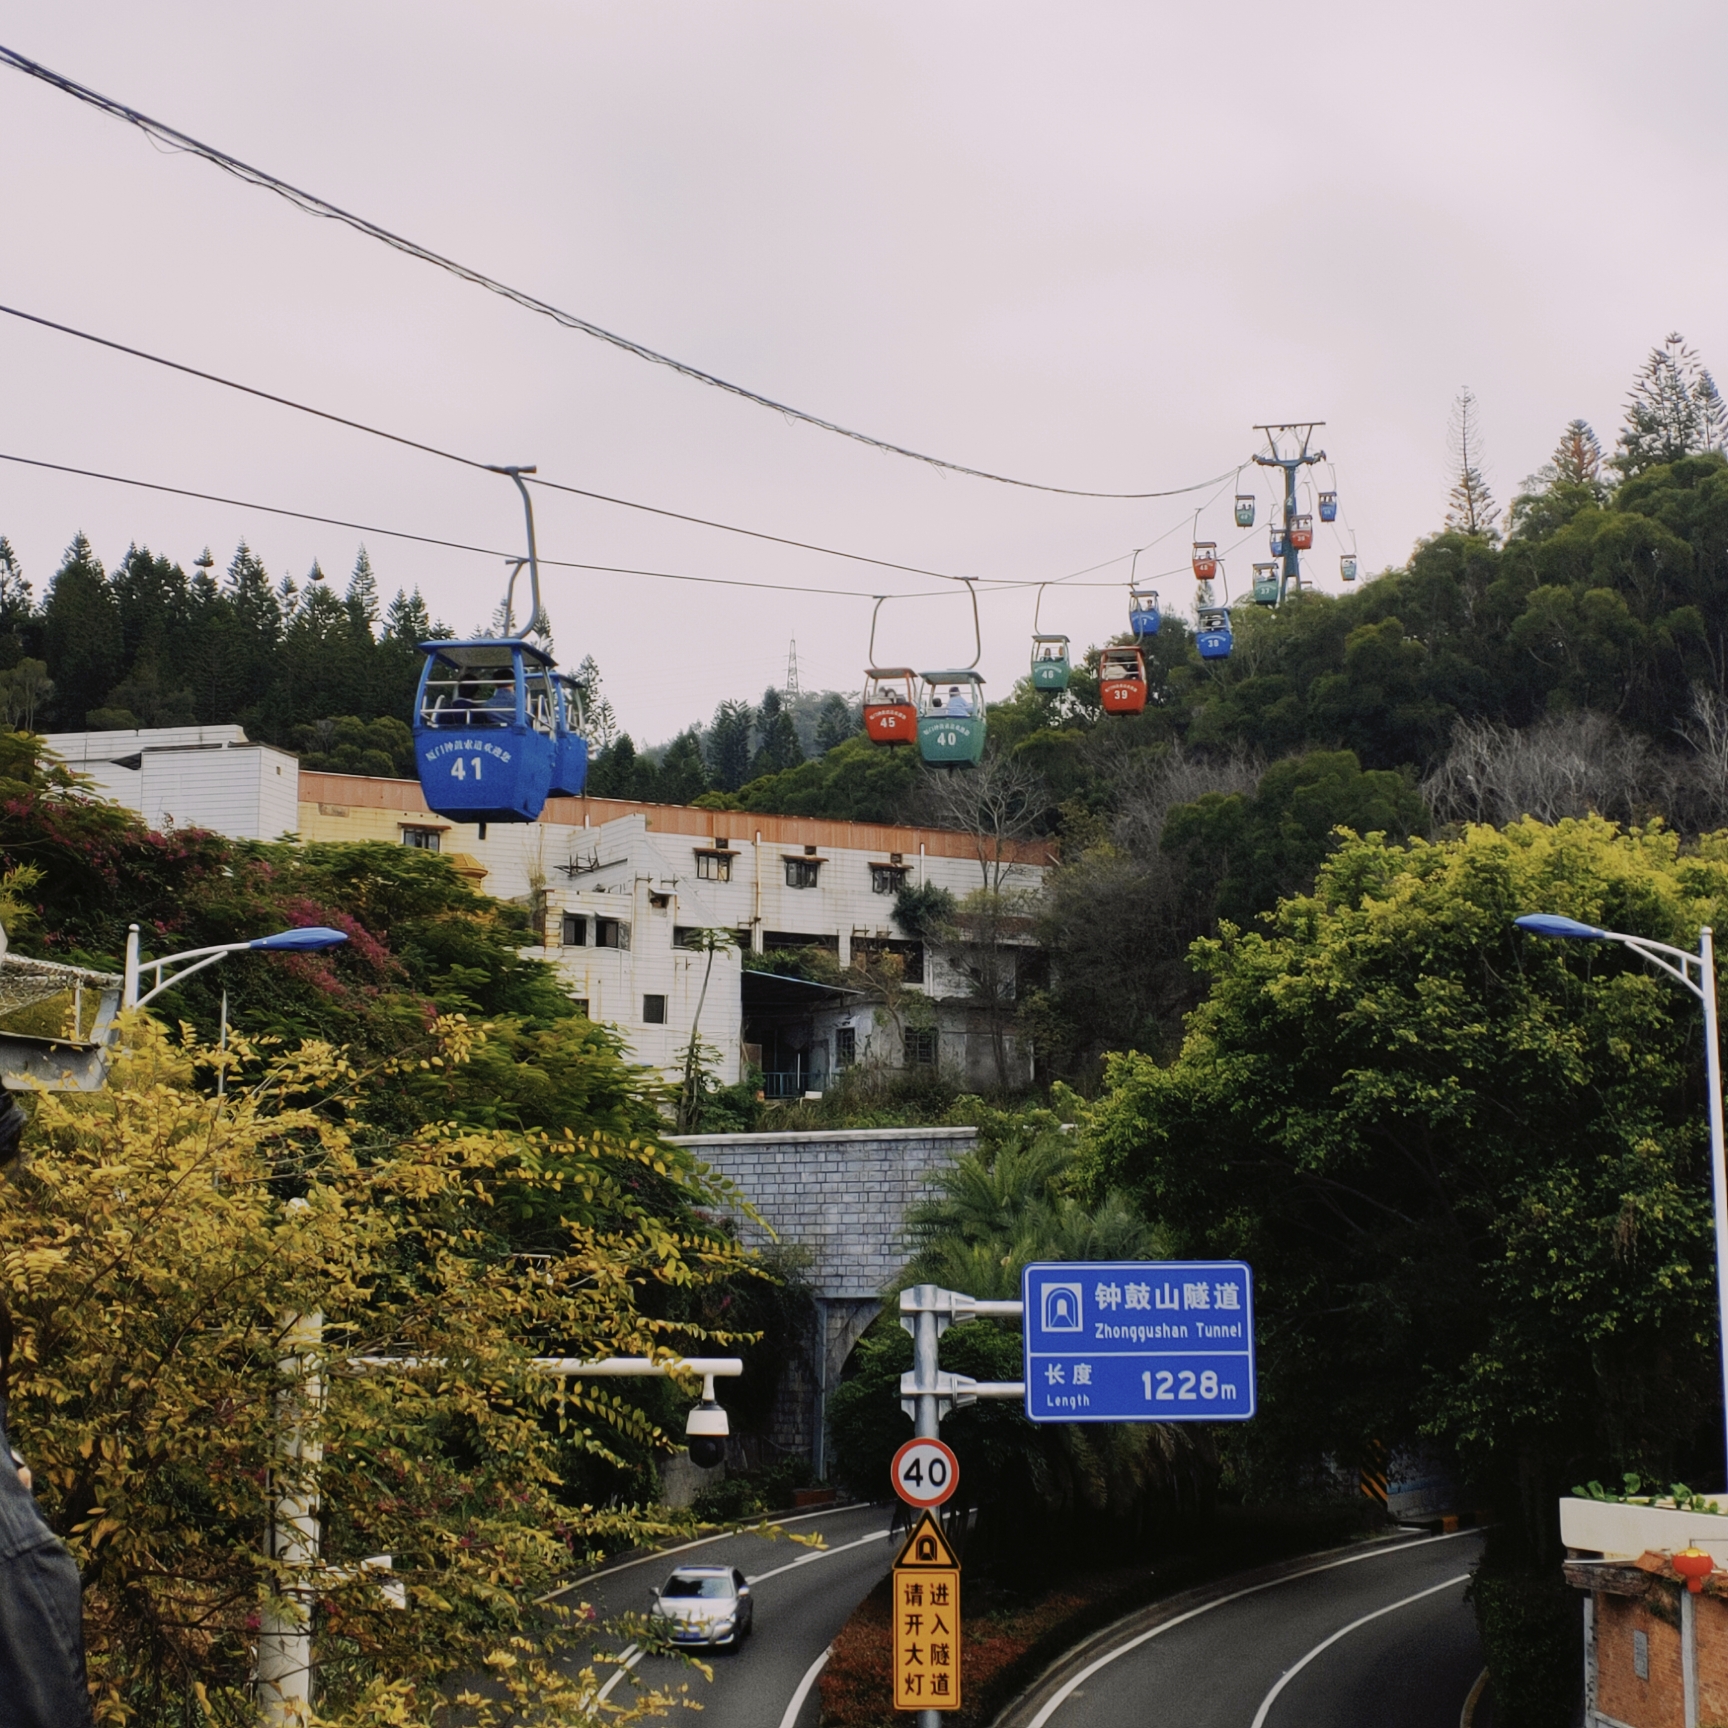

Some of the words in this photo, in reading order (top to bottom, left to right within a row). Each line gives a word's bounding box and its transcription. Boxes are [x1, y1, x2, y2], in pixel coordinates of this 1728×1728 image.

[1114, 689, 1128, 699] 39
[880, 717, 896, 728] 45
[937, 732, 957, 746] 40
[450, 757, 482, 780] 41
[1094, 1281, 1241, 1311] 钟鼓山隧道
[1094, 1322, 1189, 1343] Zhonggushan
[1196, 1321, 1242, 1339] Tunnel
[1044, 1363, 1093, 1386] 长度
[1142, 1370, 1237, 1401] 1228m
[1046, 1394, 1090, 1410] Length
[903, 1457, 947, 1488] 40
[904, 1583, 925, 1696] 请开大灯
[930, 1582, 950, 1696] 进入隧道
